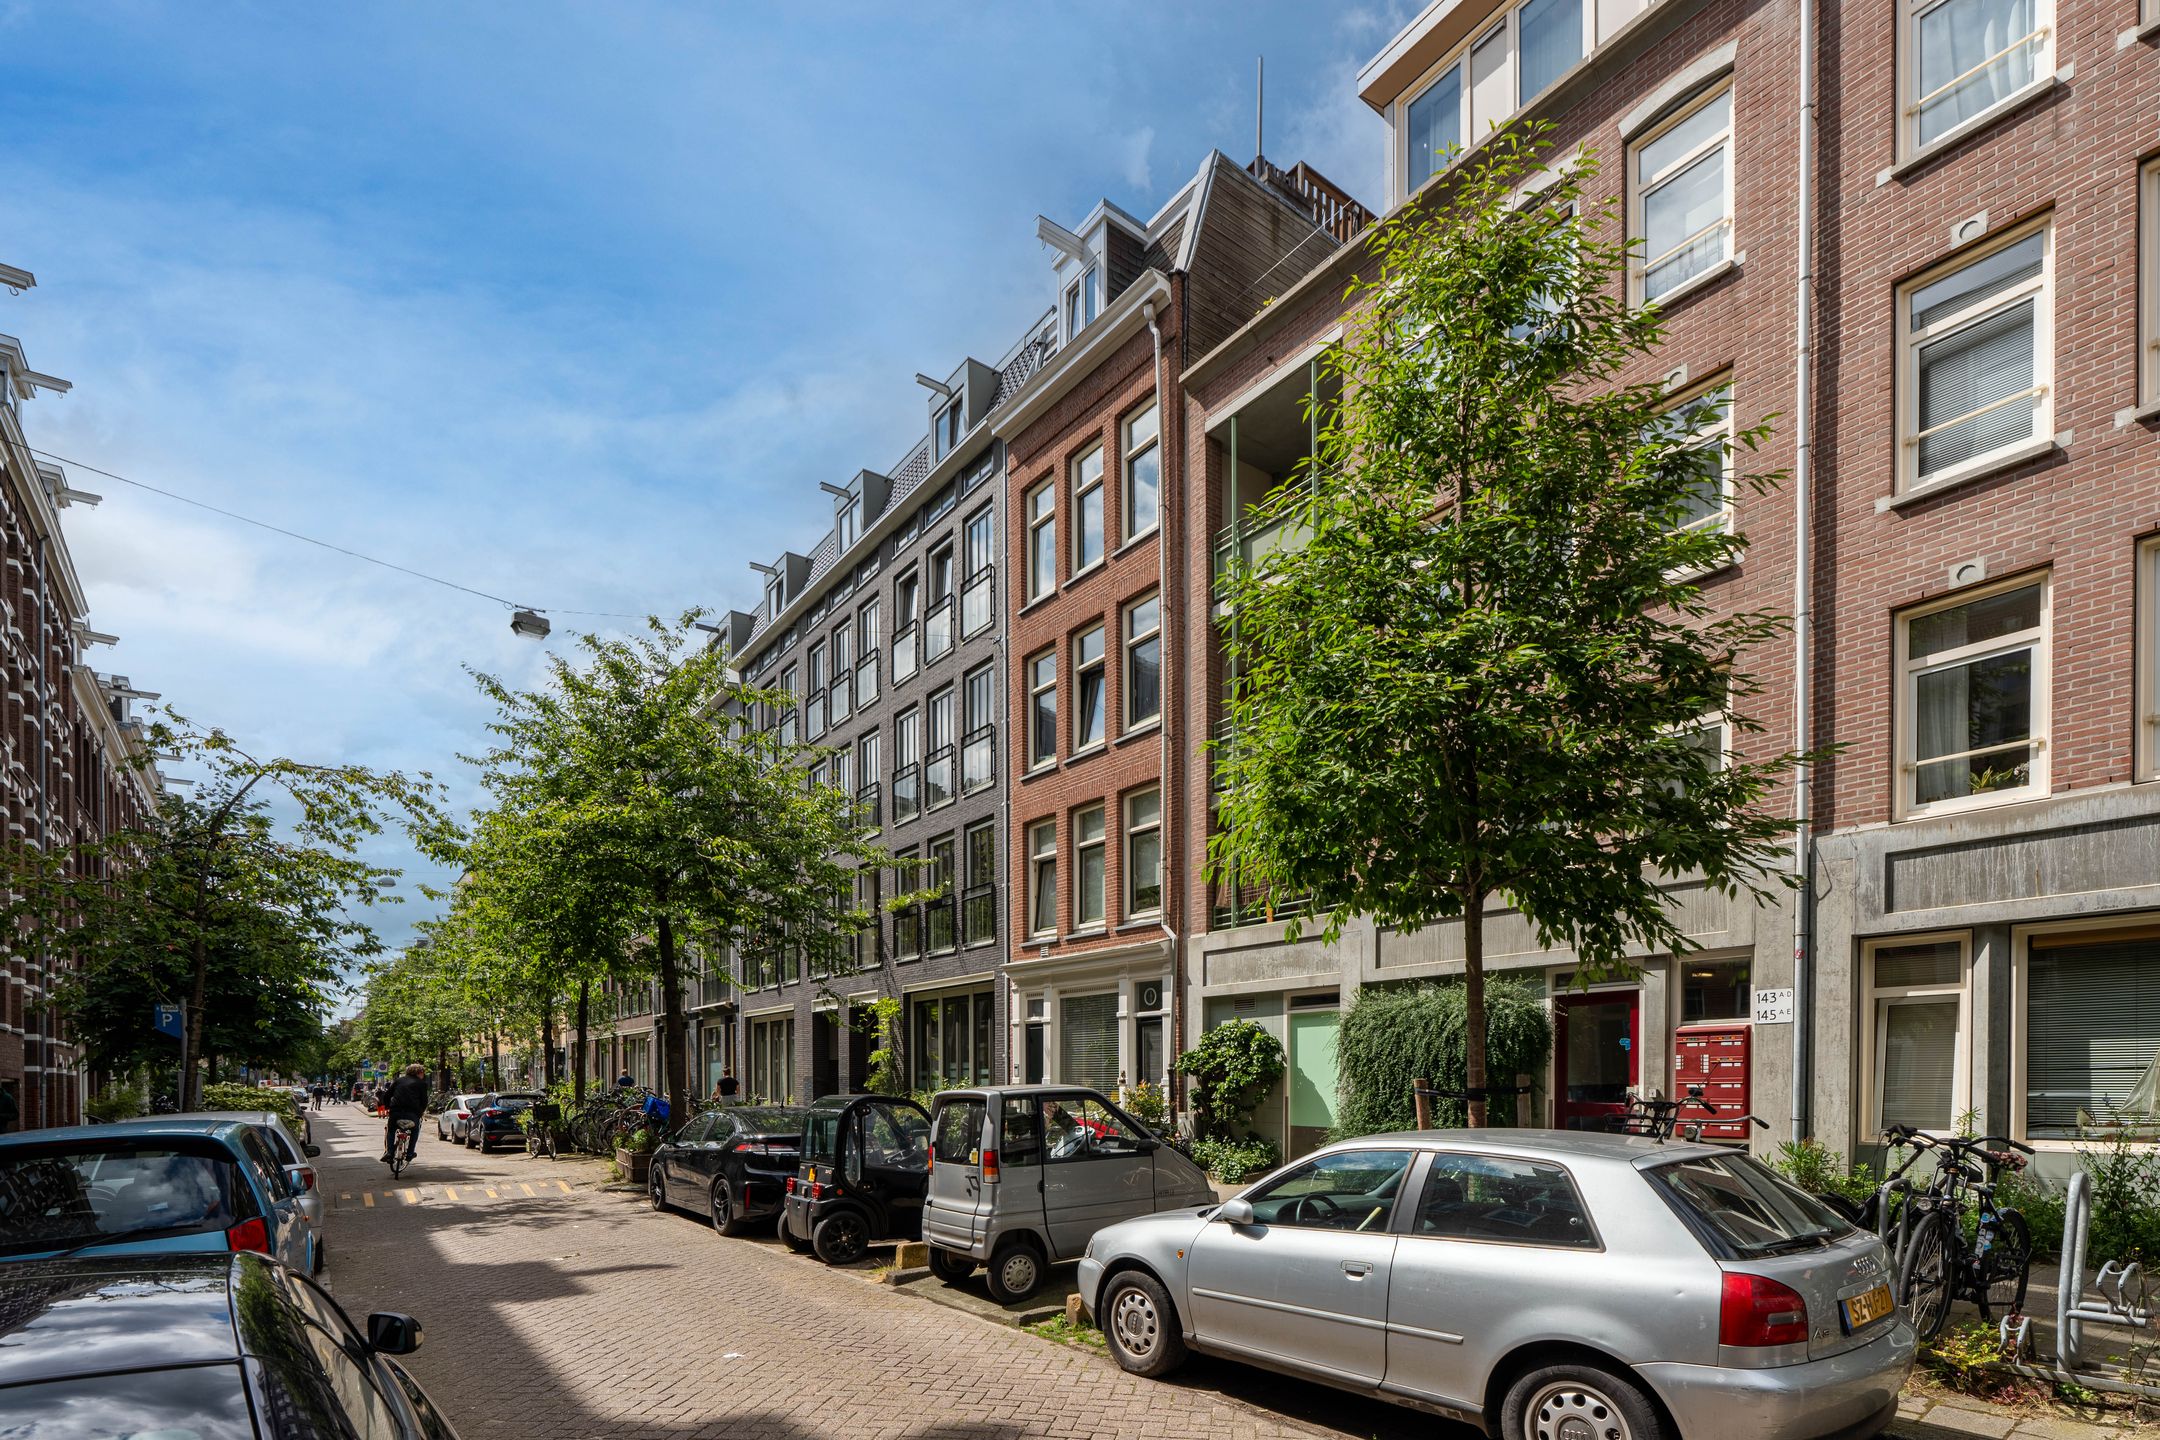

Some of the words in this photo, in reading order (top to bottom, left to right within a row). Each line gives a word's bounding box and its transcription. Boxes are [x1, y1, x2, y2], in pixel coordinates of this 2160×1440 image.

[1756, 992, 1777, 1004] 143
[162, 1013, 173, 1027] P
[1756, 1009, 1777, 1021] 145
